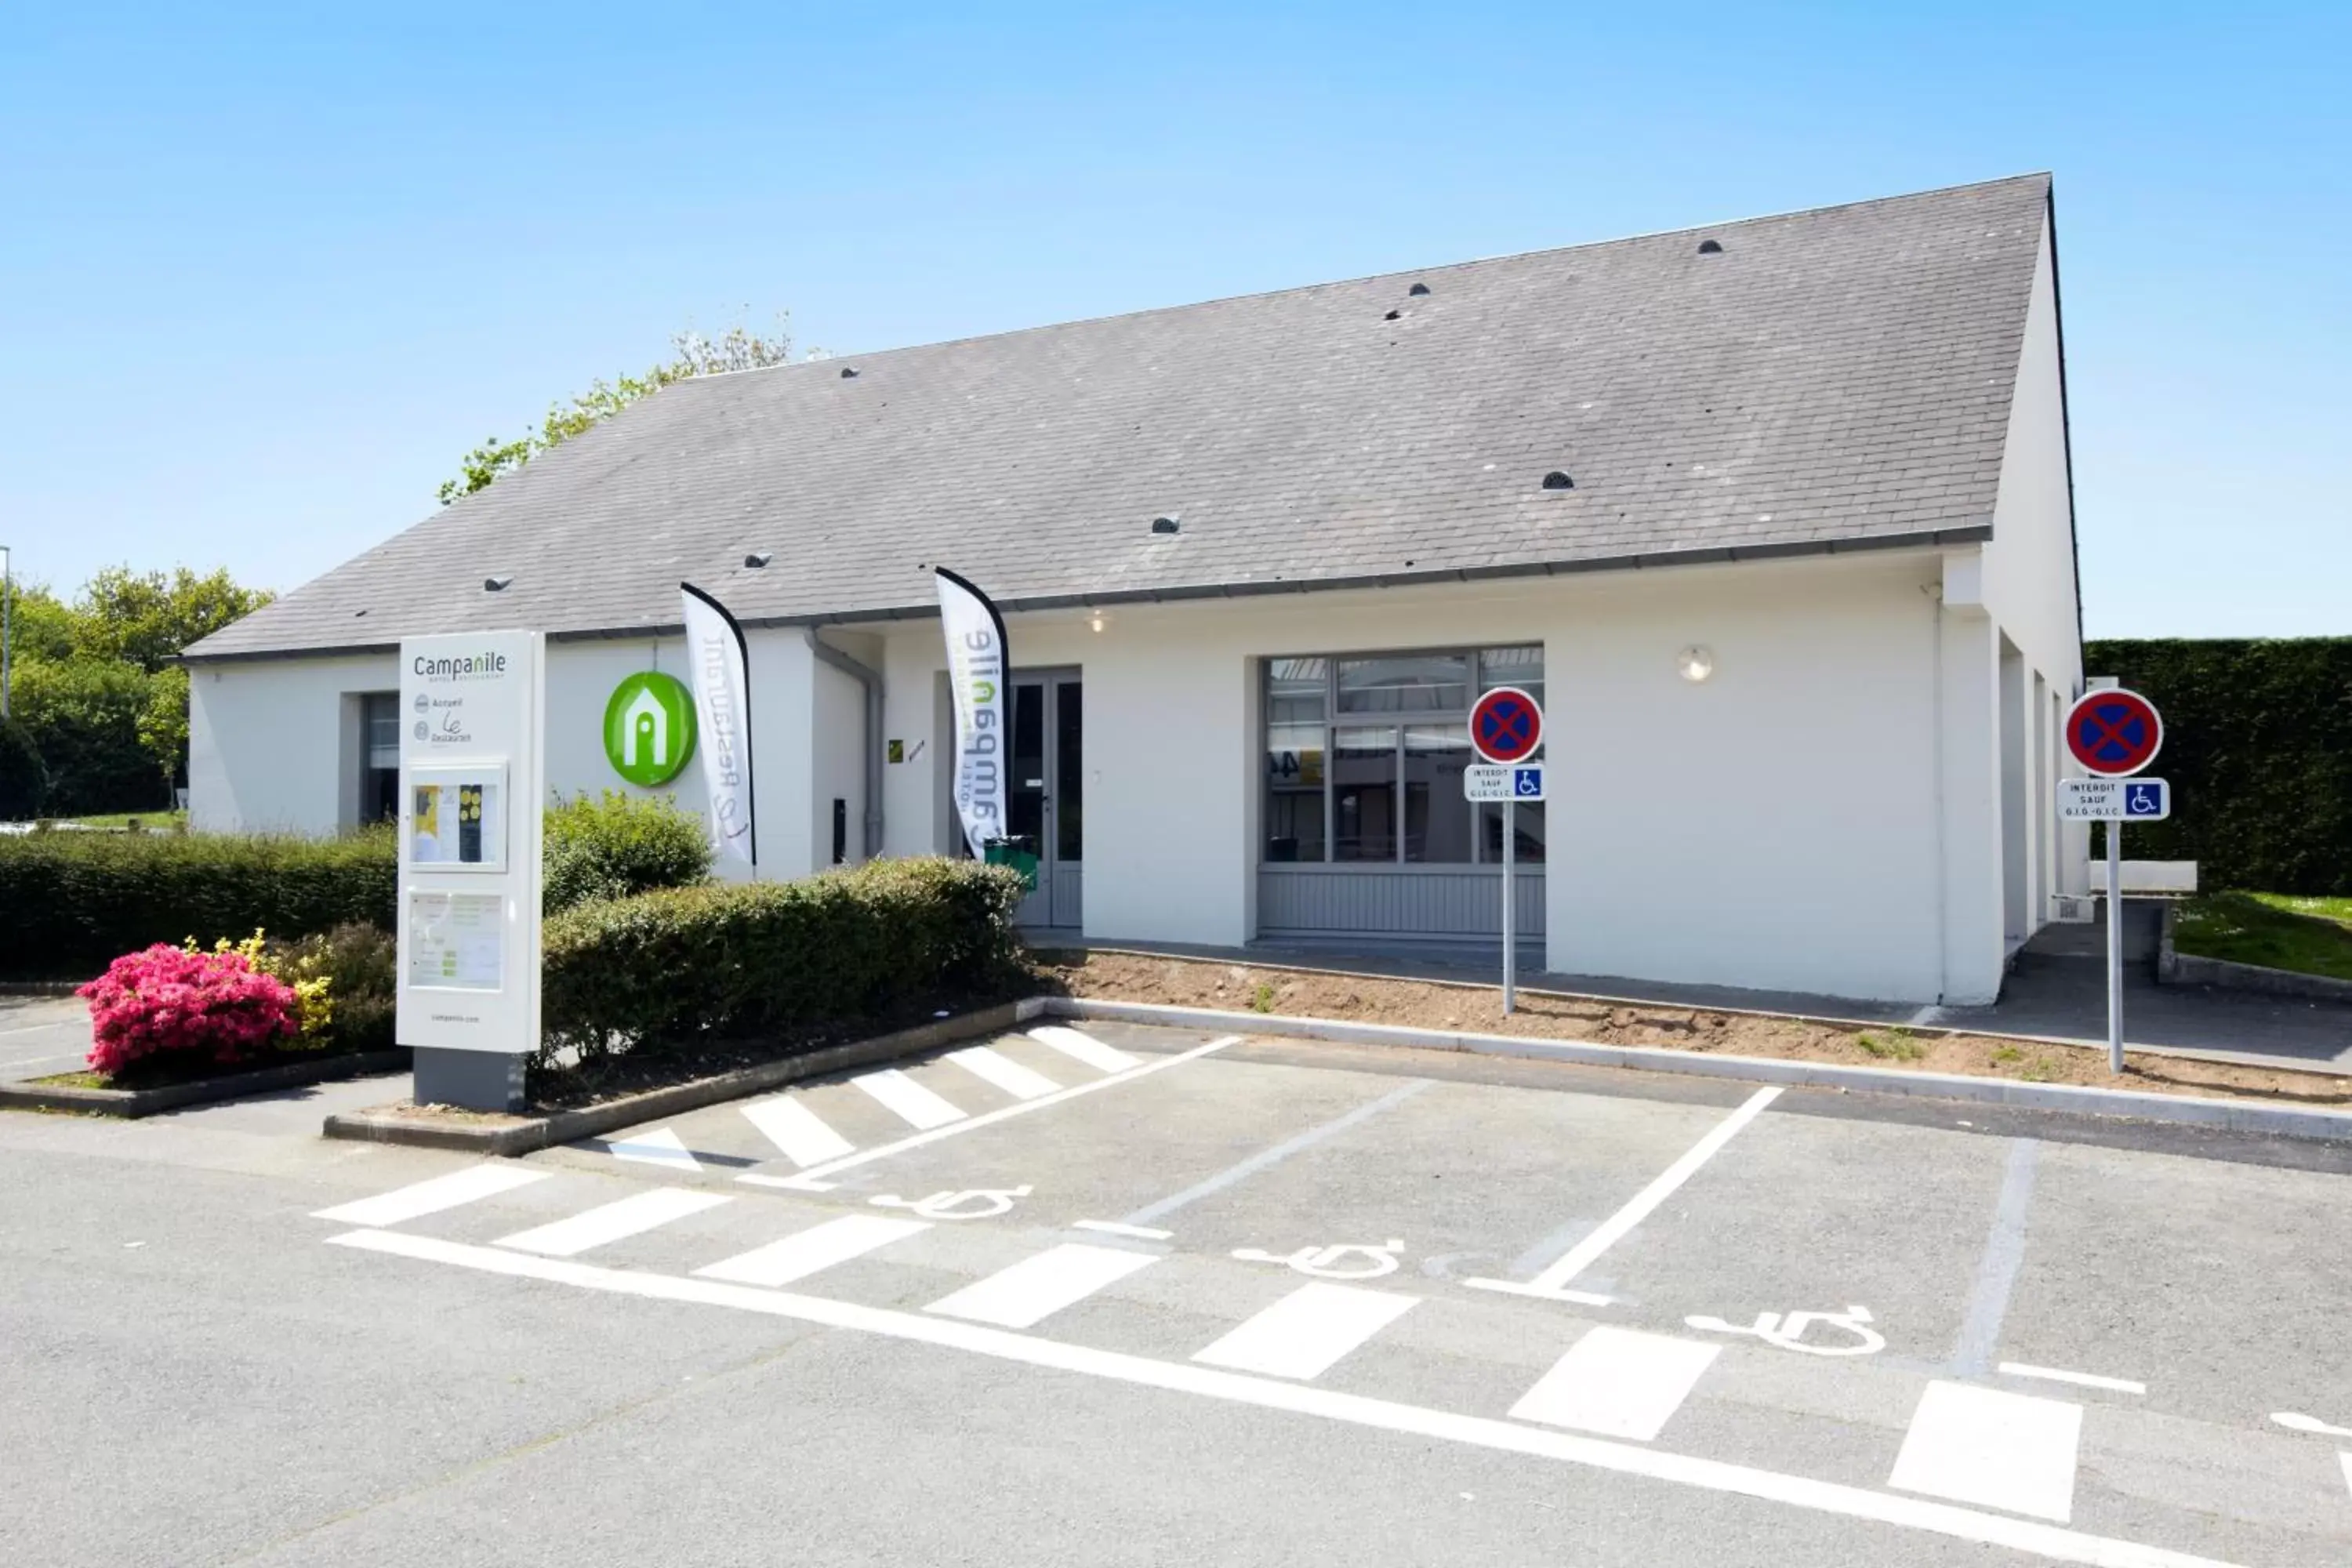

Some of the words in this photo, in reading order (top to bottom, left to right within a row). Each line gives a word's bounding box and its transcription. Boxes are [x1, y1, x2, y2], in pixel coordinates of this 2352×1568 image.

[415, 652, 506, 681] Campanile
[1474, 769, 1508, 778] INTERDIT
[2071, 783, 2115, 792] INTERDIT
